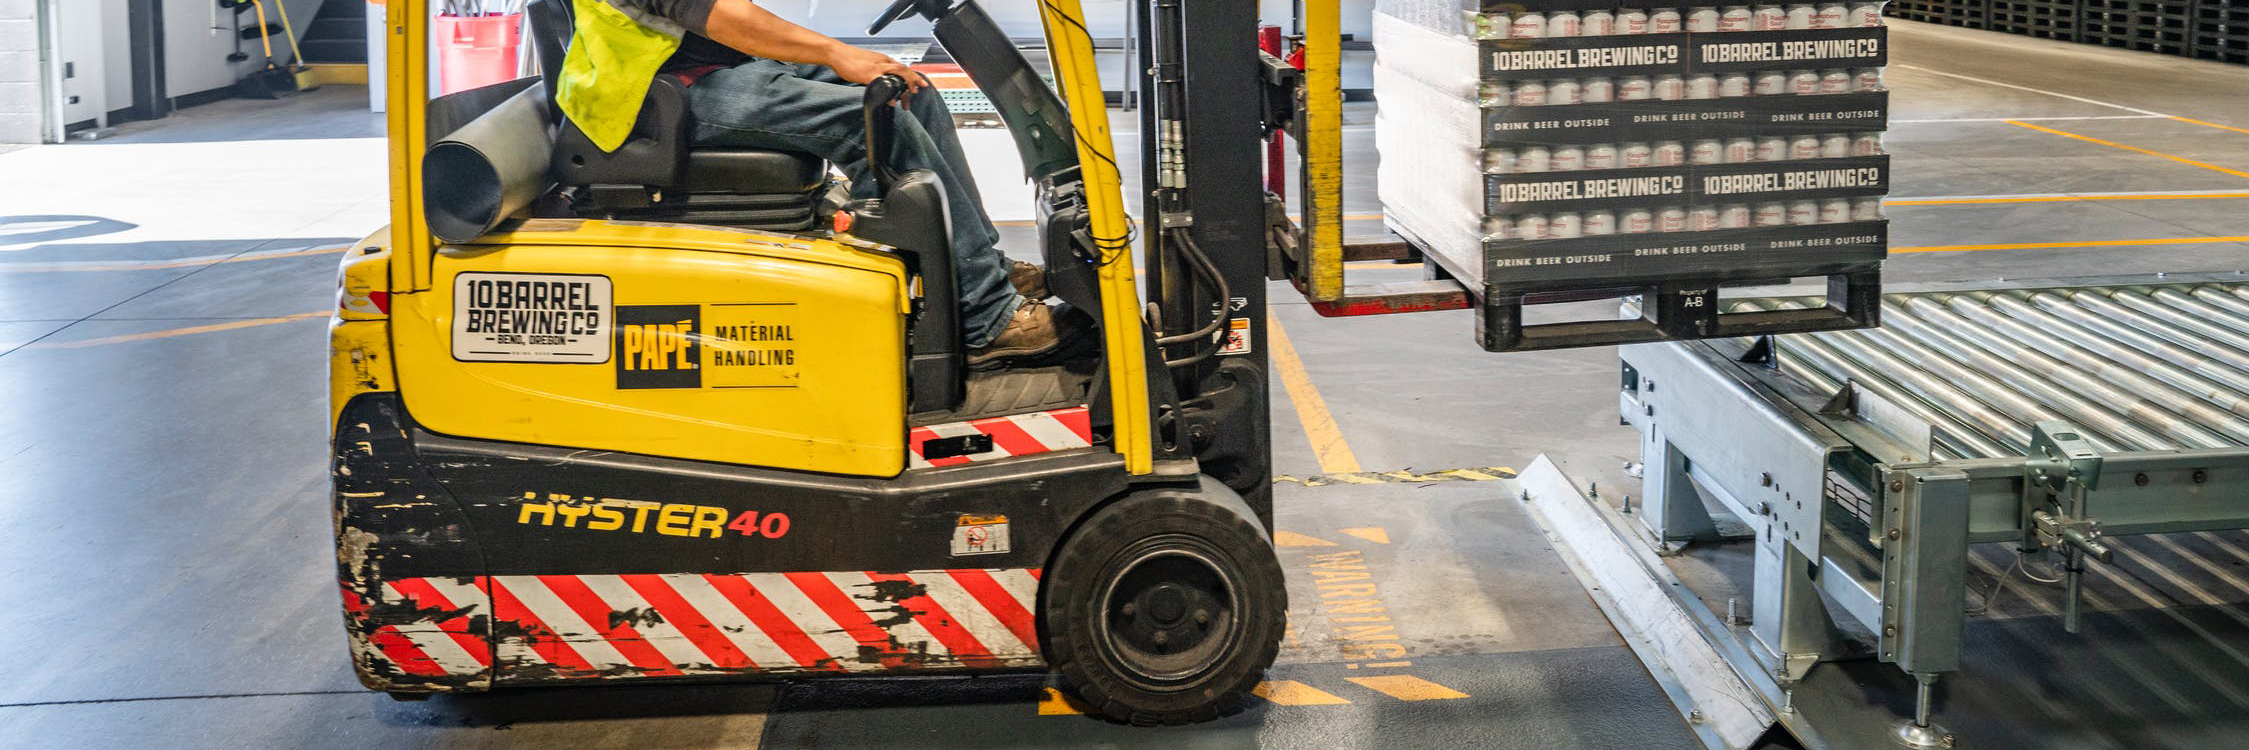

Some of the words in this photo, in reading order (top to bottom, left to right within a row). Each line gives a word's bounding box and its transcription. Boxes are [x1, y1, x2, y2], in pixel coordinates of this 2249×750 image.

[1634, 114, 1668, 123] DRINK
[1672, 113, 1696, 122] BEER
[1700, 110, 1744, 120] OUTSIDE
[1771, 113, 1804, 122] DRINK
[1808, 112, 1832, 120] BEER
[1836, 110, 1880, 118] OUTSIDE
[1494, 122, 1530, 132] DRINK
[1534, 121, 1560, 129] BEER
[1564, 118, 1610, 128] OUTSIDE
[1770, 240, 1804, 248] DRINK
[1808, 238, 1832, 246] BEER
[1835, 235, 1878, 244] OUTSIDE
[1634, 247, 1668, 256] DRINK
[1672, 246, 1698, 254] BEER
[1702, 243, 1746, 253] OUTSIDE
[1496, 258, 1532, 267] DRINK
[1536, 256, 1562, 265] BEER
[1566, 254, 1612, 264] OUTSIDE
[1684, 296, 1704, 308] A-B
[497, 334, 526, 346] BEND,
[528, 335, 566, 346] OREGON
[714, 325, 794, 342] MATERIAL
[714, 350, 794, 366] HANDLING
[518, 491, 729, 539] HYSTER
[727, 510, 791, 540] 40
[1306, 550, 1412, 670] WARNING!
